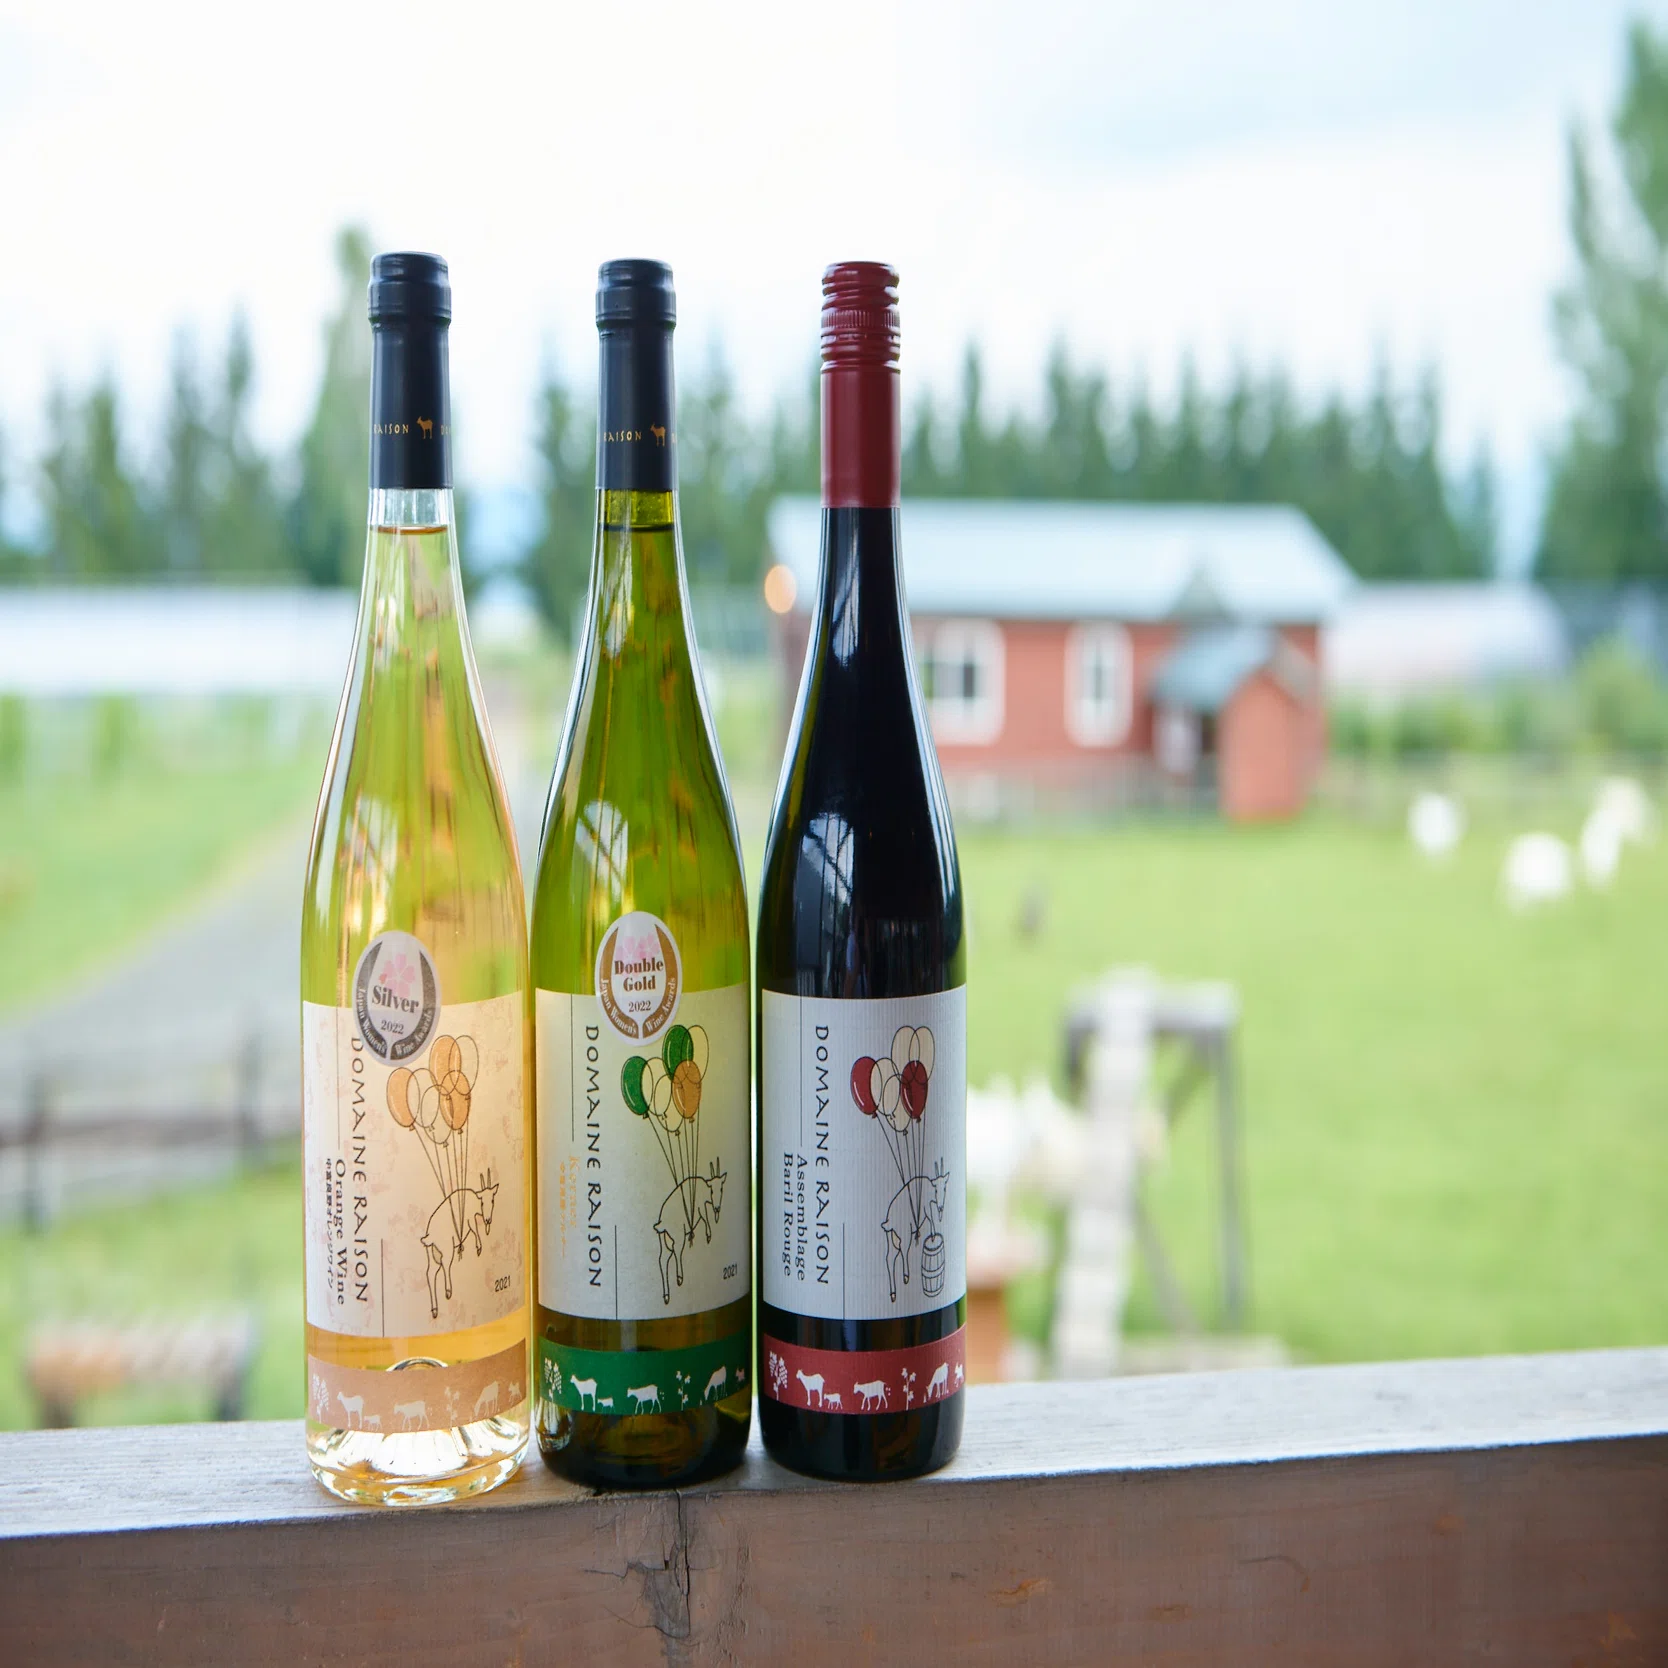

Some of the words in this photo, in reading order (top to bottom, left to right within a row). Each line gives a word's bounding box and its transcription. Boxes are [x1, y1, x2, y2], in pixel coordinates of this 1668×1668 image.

[614, 957, 664, 975] Double
[623, 975, 656, 992] Gold
[372, 985, 419, 1013] Silver
[381, 1019, 405, 1035] 2022
[601, 978, 613, 1009] Japan
[645, 1014, 664, 1032] Wine
[664, 977, 676, 1015] Awards
[629, 1000, 651, 1013] 2022
[394, 1041, 415, 1057] Wine
[351, 1037, 367, 1182] DOMAINE
[586, 1025, 601, 1169] DOMAINE
[815, 1025, 830, 1167] DOMAINE
[333, 1159, 346, 1240] Orange
[784, 1152, 794, 1203] Baril
[587, 1182, 602, 1287] RAISON
[782, 1210, 794, 1277] Rouge
[795, 1154, 808, 1281] Assemblage
[815, 1181, 830, 1285] RAISON
[337, 1247, 348, 1305] Wine
[354, 1196, 368, 1302] RAISON
[723, 1263, 738, 1280] 2021
[494, 1275, 511, 1292] 2021
